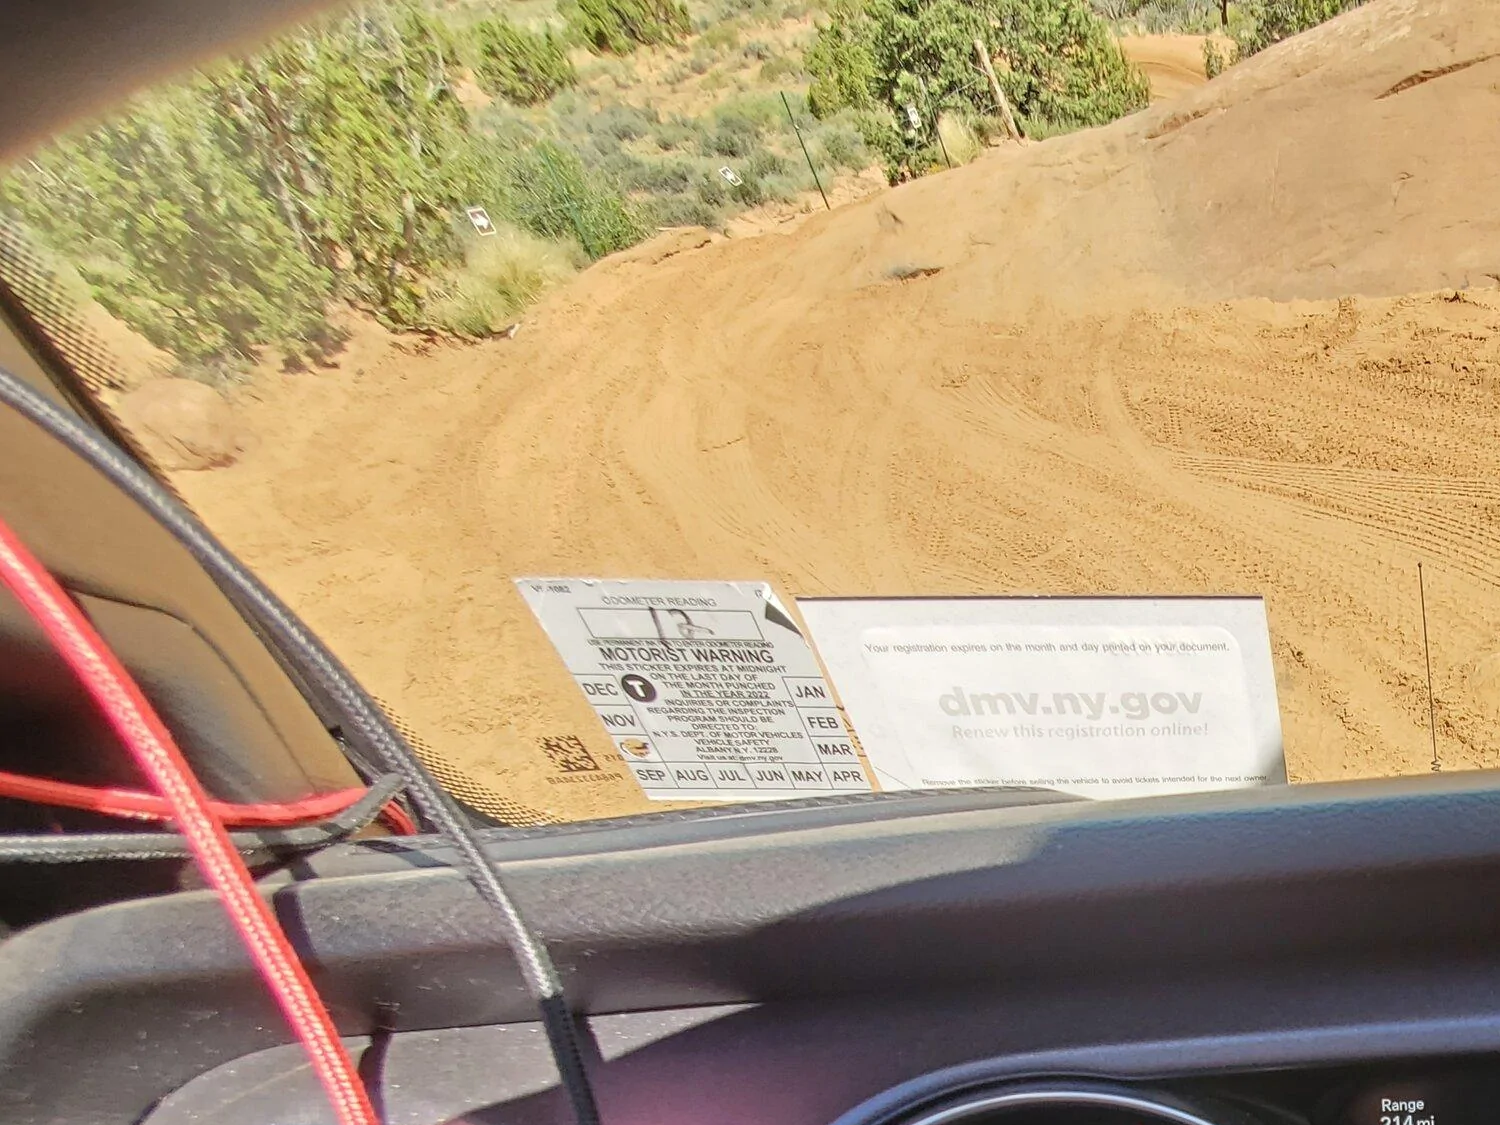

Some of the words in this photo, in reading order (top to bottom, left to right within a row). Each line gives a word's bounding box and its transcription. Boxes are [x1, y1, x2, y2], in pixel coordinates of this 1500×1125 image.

[602, 596, 665, 605] ODOMETER
[667, 598, 717, 607] READING
[864, 643, 889, 653] Your
[893, 643, 947, 654] registration
[951, 643, 987, 654] expires
[1006, 642, 1021, 651] the
[1025, 642, 1056, 651] month
[1059, 642, 1078, 651] and
[1081, 642, 1099, 653] day
[1102, 642, 1136, 654] printed
[1138, 643, 1152, 651] on
[1154, 643, 1176, 653] your
[599, 647, 689, 662] MOTORIST
[690, 648, 774, 664] WARNING
[598, 662, 625, 671] THIS
[626, 662, 674, 672] STICKER
[675, 664, 718, 673] EXPIRES
[721, 665, 734, 673] AT
[737, 665, 787, 674] MIDNIGHT
[689, 673, 717, 681] LAST
[582, 683, 619, 696] DEC
[662, 681, 683, 689] THE
[726, 682, 776, 690] PUNCHED
[680, 690, 694, 698] IN
[693, 690, 716, 698] THE
[716, 690, 744, 698] YEAR
[747, 691, 771, 699] 2022
[795, 686, 826, 699] JAN
[664, 699, 714, 707] INQUIRIES
[715, 699, 733, 707] OR
[735, 700, 795, 708] COMPLAINTS
[939, 686, 1203, 720] dmv.ny.gov
[707, 707, 726, 715] THE
[728, 708, 785, 716] INSPECTION
[601, 714, 636, 727] NOV
[807, 716, 839, 729] FEB
[691, 723, 740, 731] DIRECTED
[952, 725, 1009, 739] Renew
[1013, 724, 1045, 738] this
[1049, 723, 1146, 740] registration
[1151, 722, 1209, 737] online!
[724, 731, 758, 739] MOTOR
[735, 739, 770, 747] SAFETY
[817, 743, 852, 756] MAR
[636, 769, 666, 781] SEP
[677, 769, 709, 782] AUG
[718, 769, 746, 782] JUL
[756, 769, 786, 782] JUN
[792, 770, 824, 782] MAY
[833, 770, 864, 783] APR
[922, 778, 956, 787] Remove
[974, 777, 999, 785] sticker
[1001, 777, 1026, 785] before
[1029, 777, 1054, 786] selling
[1071, 777, 1099, 785] vehicle
[1112, 776, 1133, 784] avoid
[1135, 776, 1160, 784] tickets
[1162, 775, 1195, 783] intended
[1197, 775, 1208, 783] for
[1381, 1098, 1425, 1113] Range
